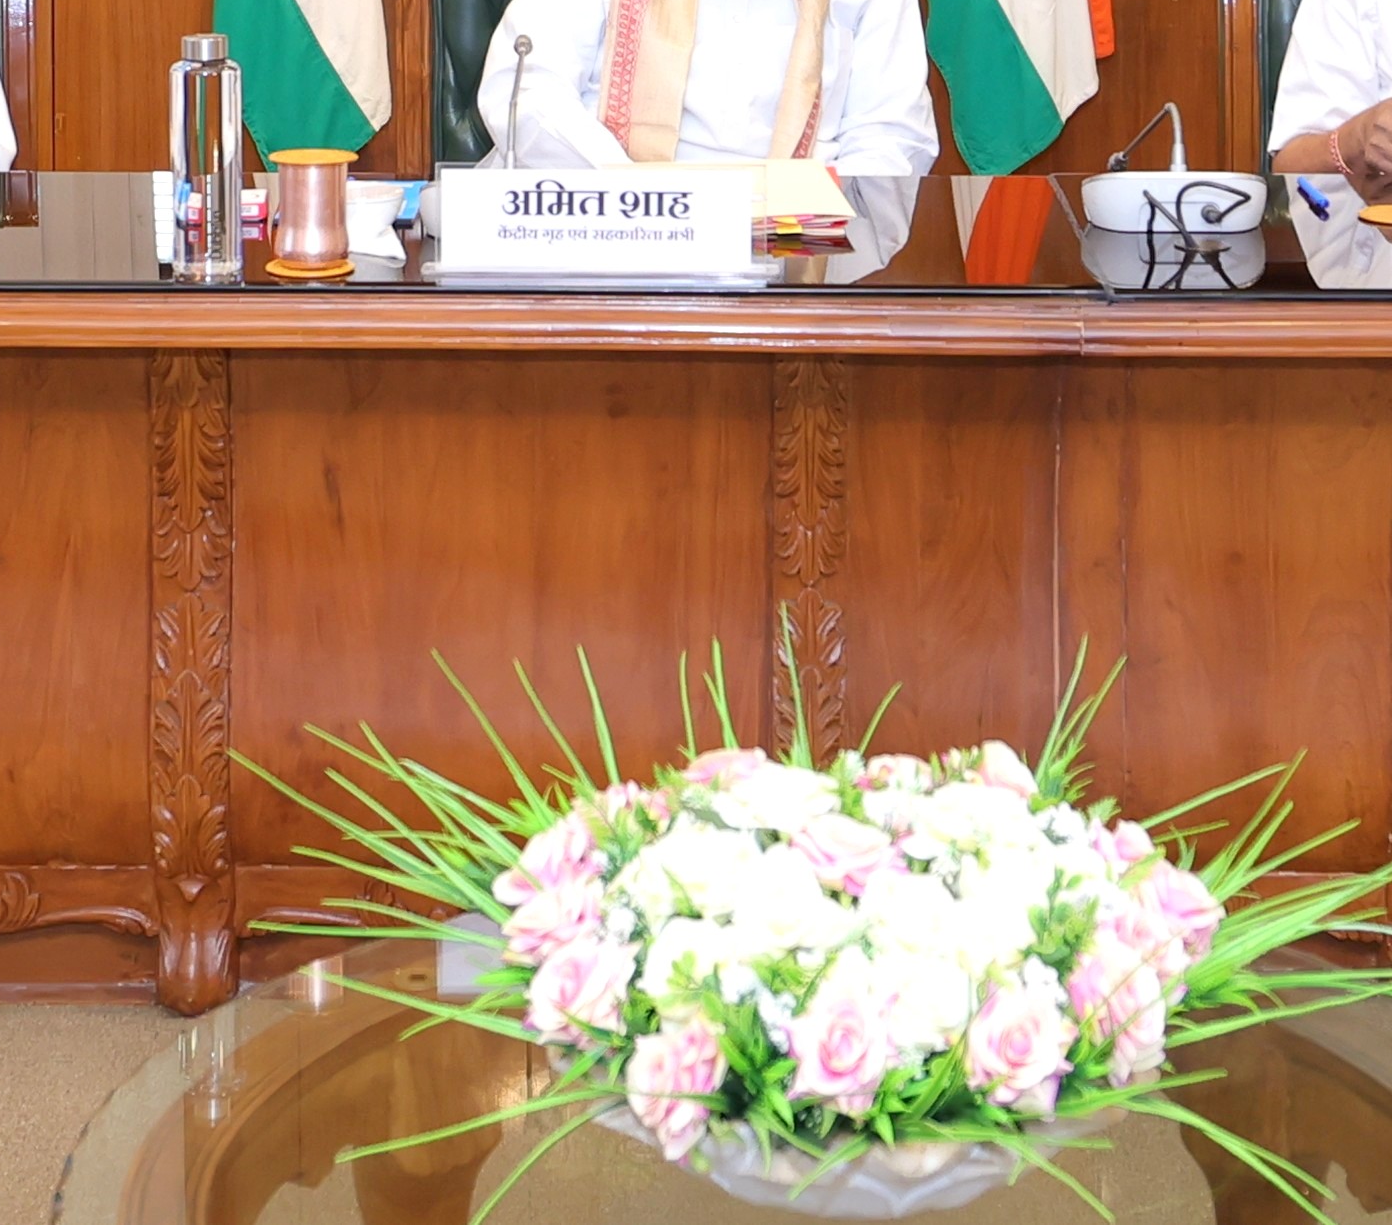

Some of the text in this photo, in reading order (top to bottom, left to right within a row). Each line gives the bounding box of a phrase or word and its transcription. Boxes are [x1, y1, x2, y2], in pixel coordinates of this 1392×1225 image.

[502, 179, 694, 220] अमित शाह
[541, 228, 565, 245] गृह
[567, 226, 589, 241] एवं
[591, 226, 664, 241] सहकारिता
[666, 227, 696, 242] मंत्री
